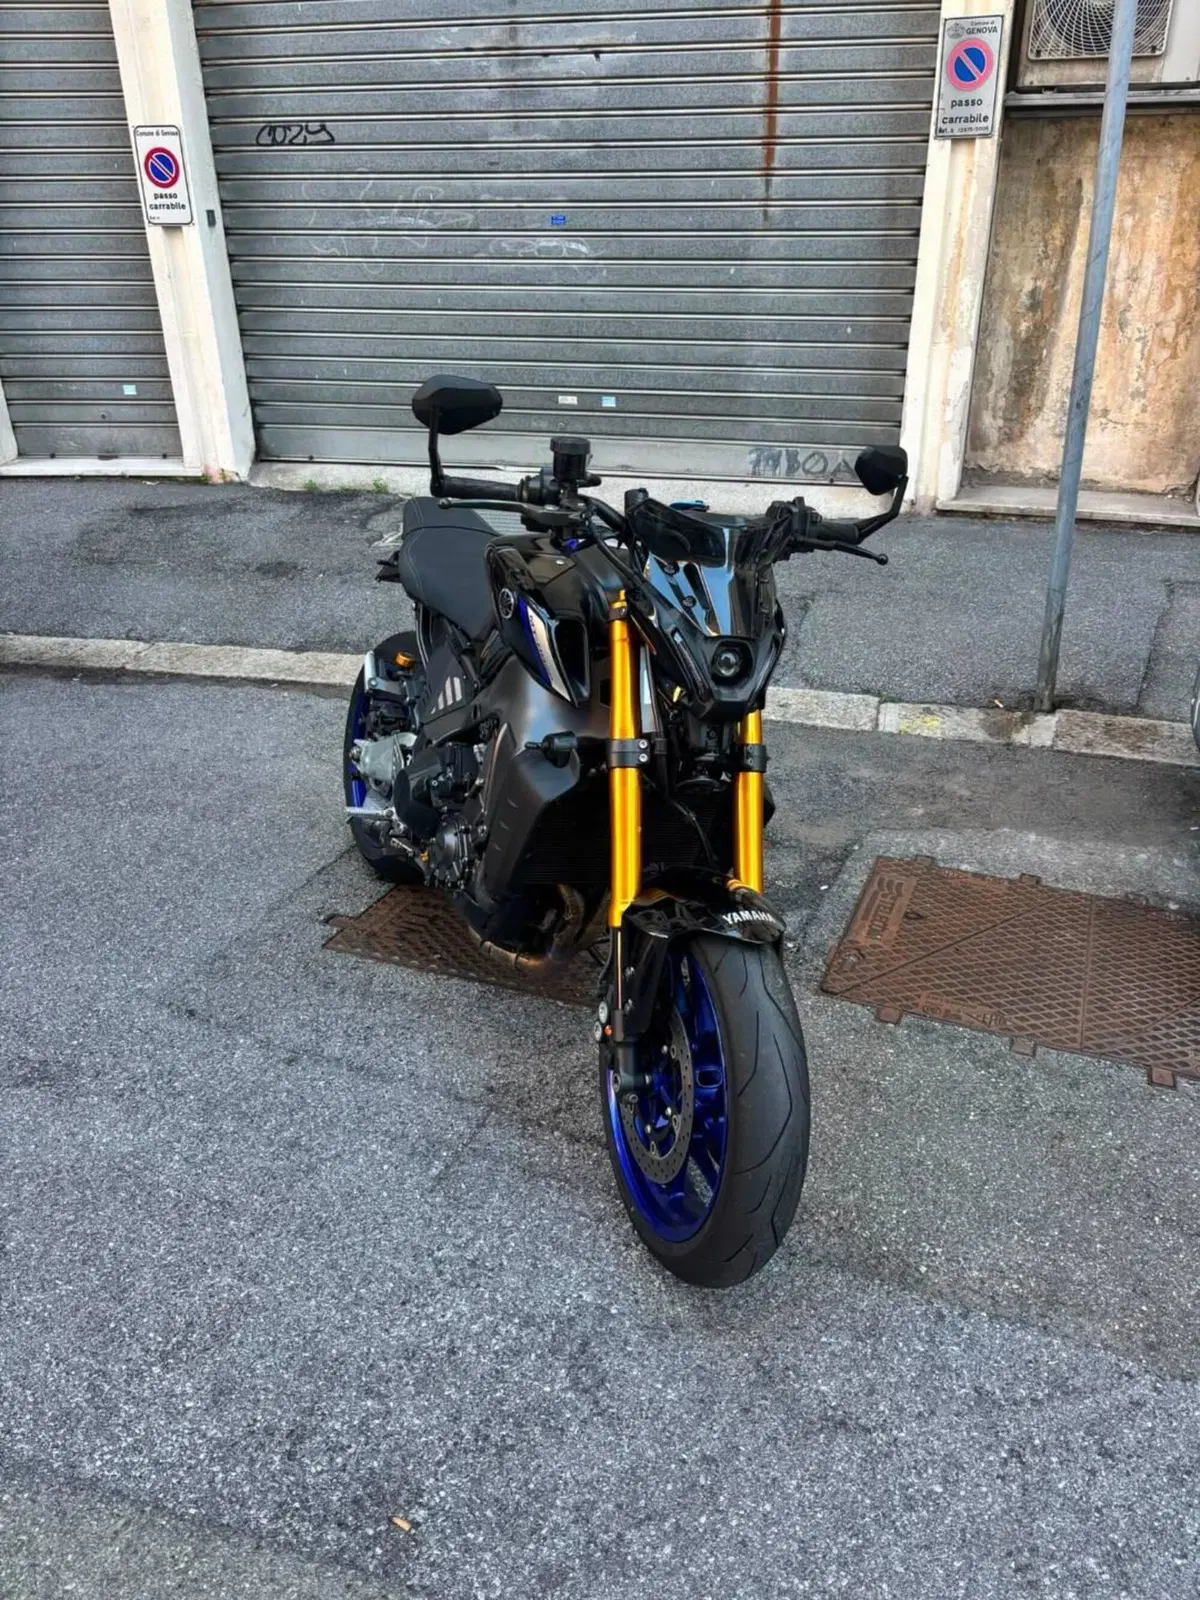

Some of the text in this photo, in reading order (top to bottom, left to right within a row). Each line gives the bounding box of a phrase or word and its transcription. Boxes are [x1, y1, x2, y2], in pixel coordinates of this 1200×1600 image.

[966, 26, 998, 35] GENOVA
[950, 98, 983, 109] passo
[941, 113, 989, 125] carrabile
[153, 192, 178, 200] passo
[149, 202, 186, 210] carrabile
[722, 910, 776, 924] YAMAHA
